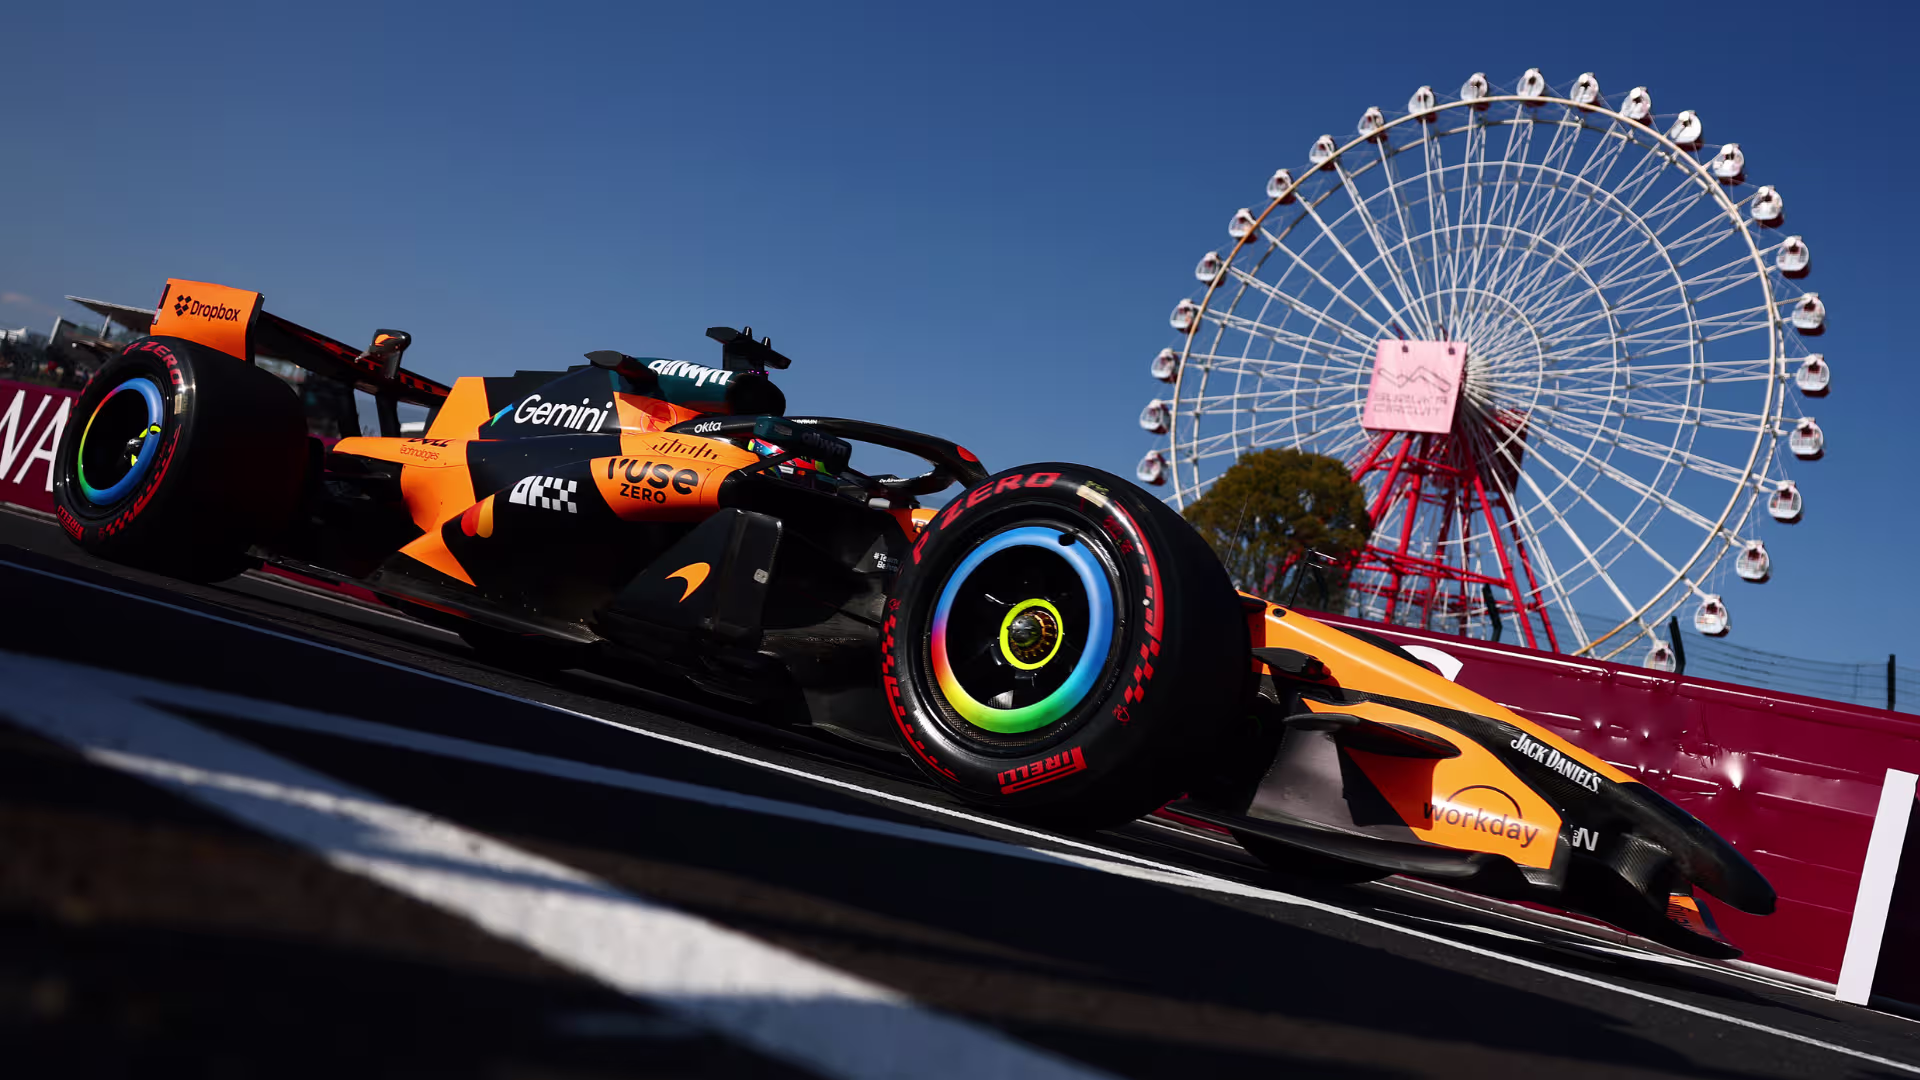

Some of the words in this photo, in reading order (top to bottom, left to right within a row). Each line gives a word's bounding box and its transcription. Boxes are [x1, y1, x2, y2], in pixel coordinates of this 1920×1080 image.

[190, 300, 241, 321] Dropbox
[140, 341, 184, 385] ZERO
[648, 359, 733, 387] allwyn
[514, 394, 613, 432] Gemini
[694, 420, 722, 434] okta
[619, 483, 667, 504] ZERO
[940, 472, 1062, 530] ZERO
[57, 505, 84, 541] PIRELLI
[1510, 733, 1550, 763] JACK
[997, 746, 1087, 795] PIRELLI
[1424, 801, 1539, 848] workday
